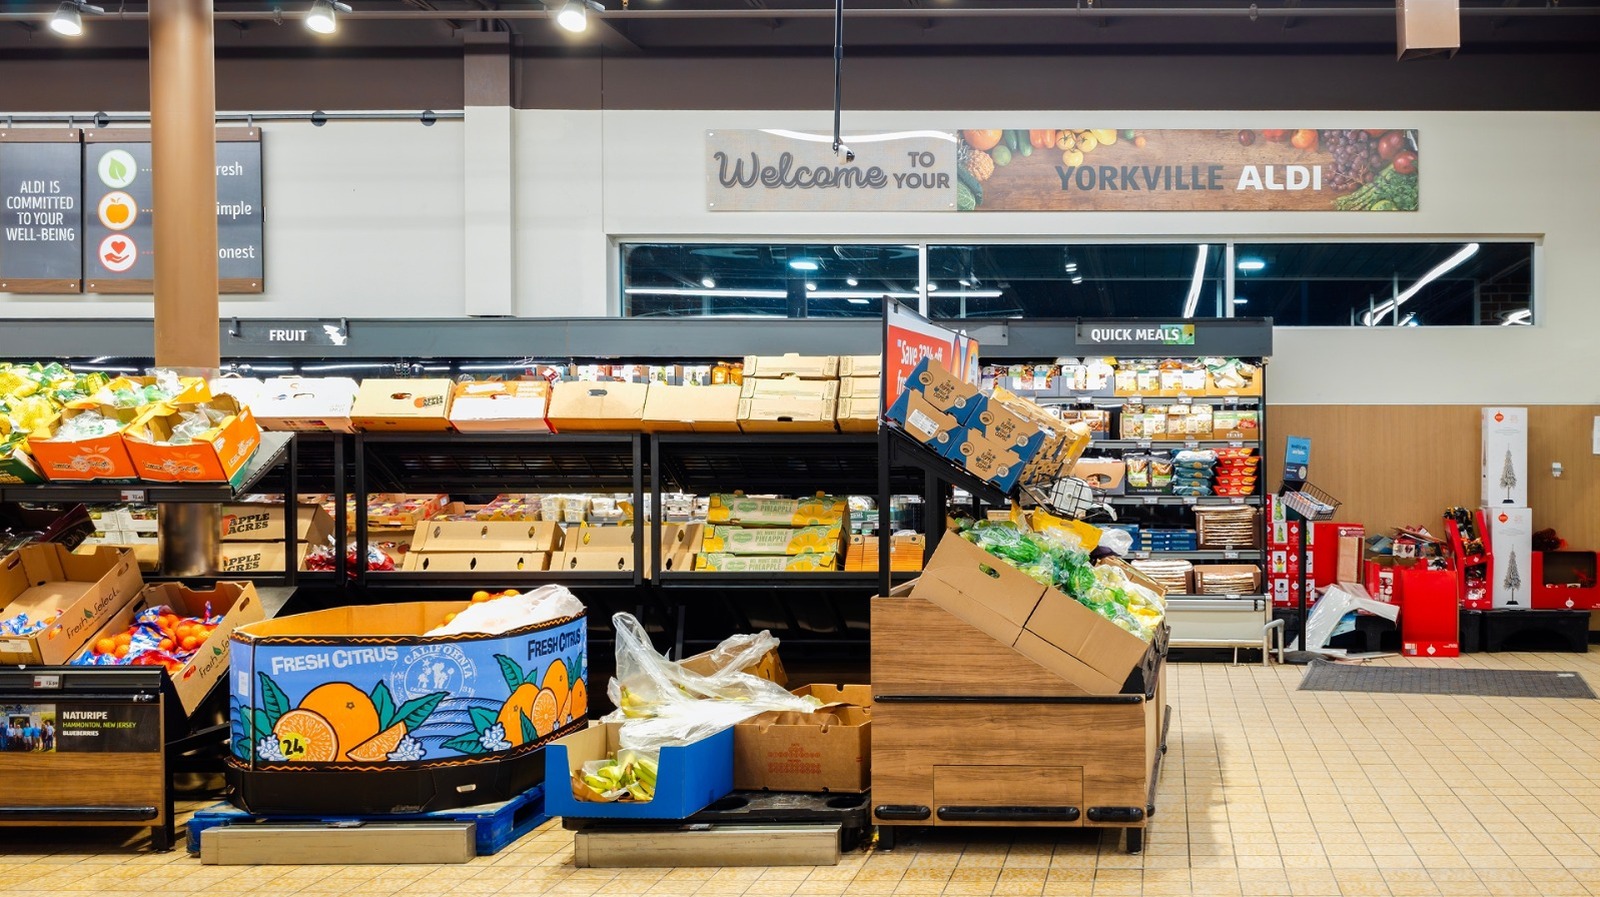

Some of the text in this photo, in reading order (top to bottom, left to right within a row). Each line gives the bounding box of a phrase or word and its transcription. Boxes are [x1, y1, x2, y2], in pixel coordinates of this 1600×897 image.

[908, 151, 935, 167] TO
[216, 162, 243, 175] resh
[714, 151, 888, 188] Welcome
[893, 173, 950, 188] YOUR
[1055, 165, 1322, 190] YORKVILLE ALDI
[20, 180, 60, 194] ALDI IS
[6, 196, 74, 210] COMMITTED
[216, 202, 252, 219] imple
[17, 212, 64, 225] TO YOUR
[6, 228, 75, 241] WELL-BEING
[218, 244, 255, 259] onest
[269, 329, 307, 342] FRUIT
[1091, 328, 1180, 342] QUICK MEALS
[229, 513, 270, 526] APPLE
[228, 521, 269, 535] ACRES
[755, 535, 787, 543] PINEAPPLE
[223, 562, 260, 571] CRES
[748, 563, 780, 571] PINEAPPLE
[66, 617, 88, 639] Fresh
[93, 587, 117, 615] Select
[527, 628, 581, 661] FRESH CITRUS
[199, 655, 218, 678] Fresh
[271, 645, 399, 676] FRESH CITRUS
[404, 644, 473, 679] CALIFORNIA
[62, 711, 108, 720] NATURIPE
[282, 738, 304, 755] 24
